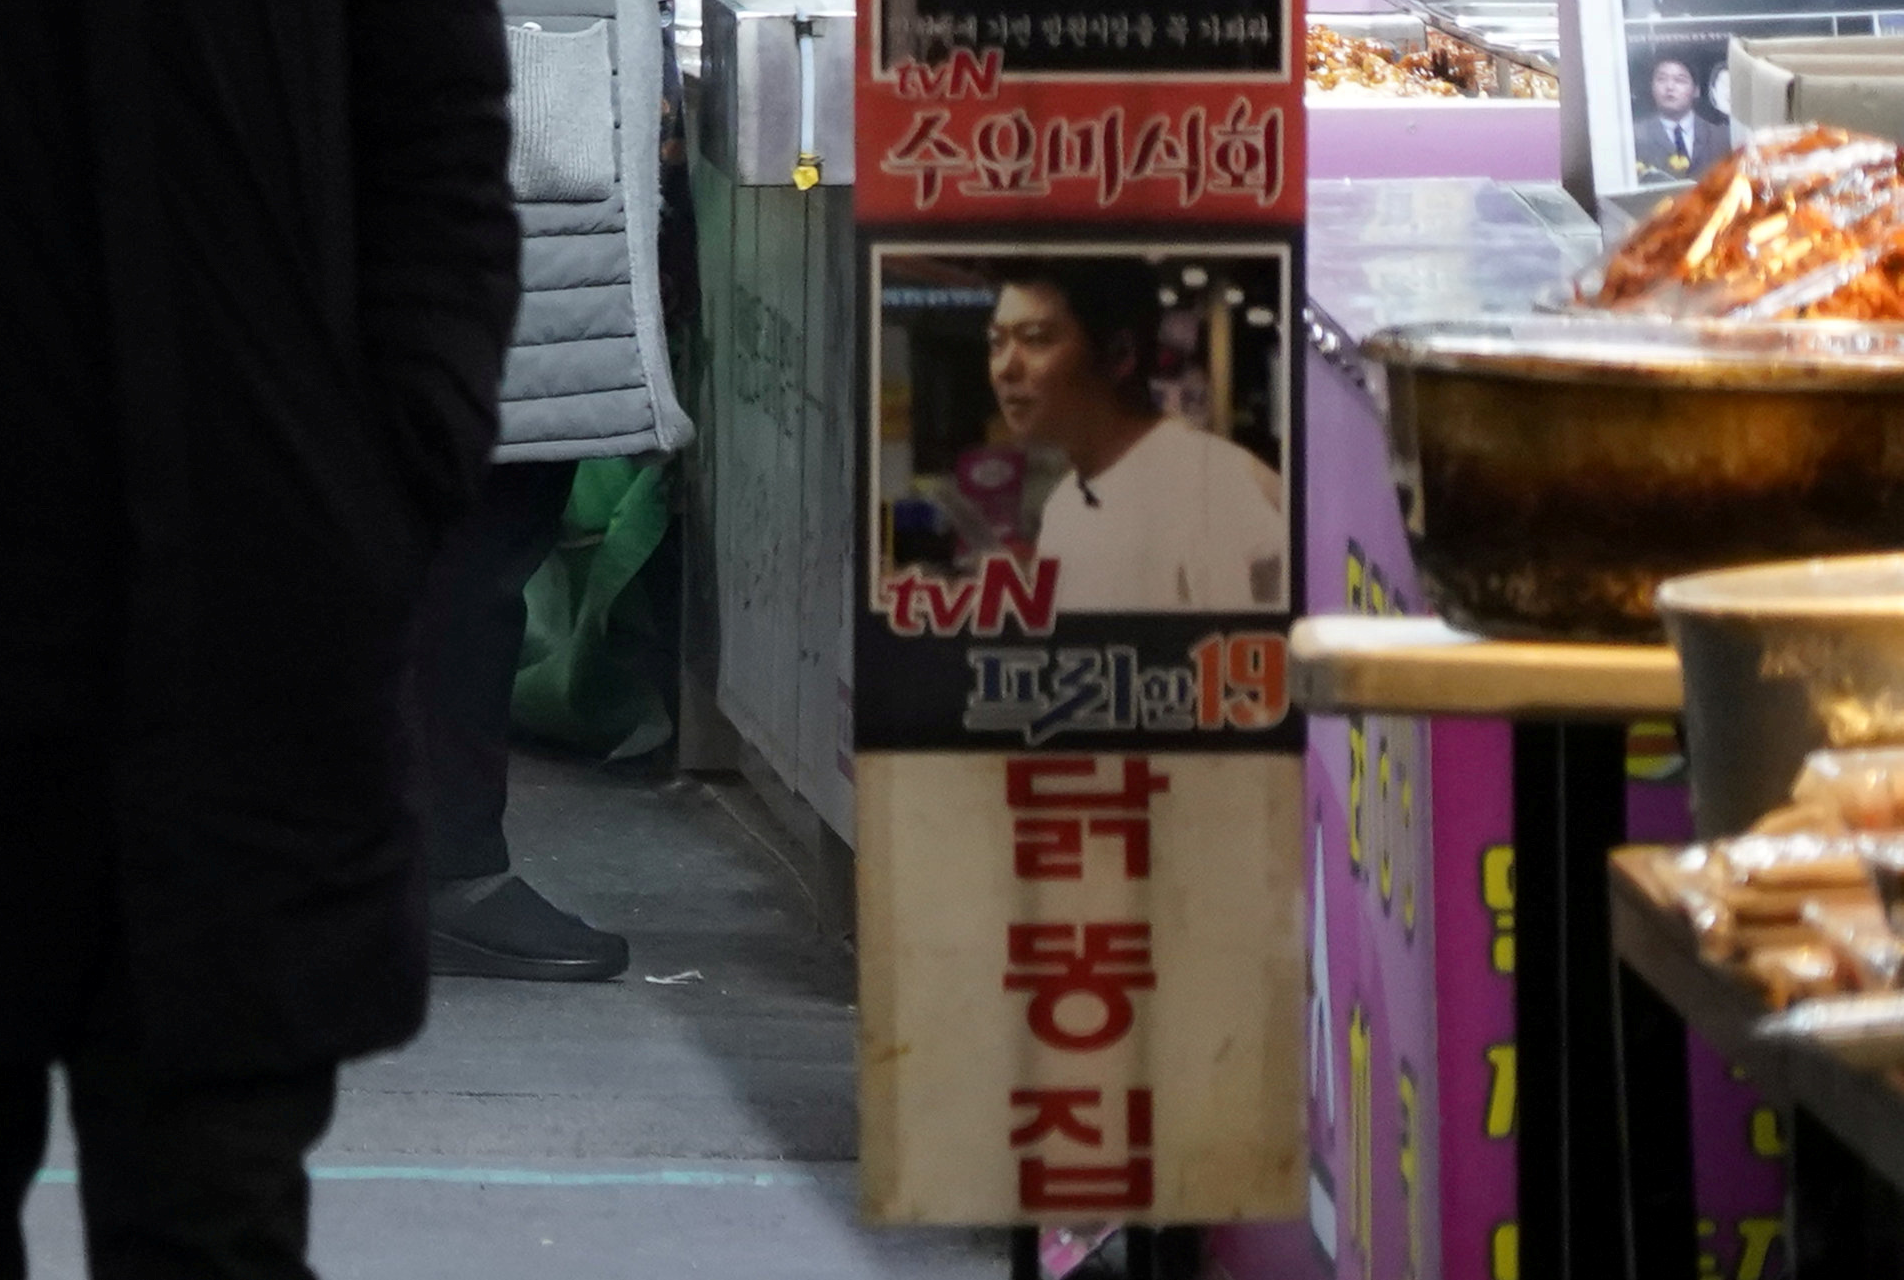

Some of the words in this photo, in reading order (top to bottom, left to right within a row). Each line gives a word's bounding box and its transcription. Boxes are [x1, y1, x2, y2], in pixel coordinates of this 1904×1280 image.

[893, 46, 1003, 100] tvN
[881, 95, 1284, 210] 수요미식회
[885, 553, 1061, 637] tvN
[1003, 759, 1170, 1211] 닭똥집
